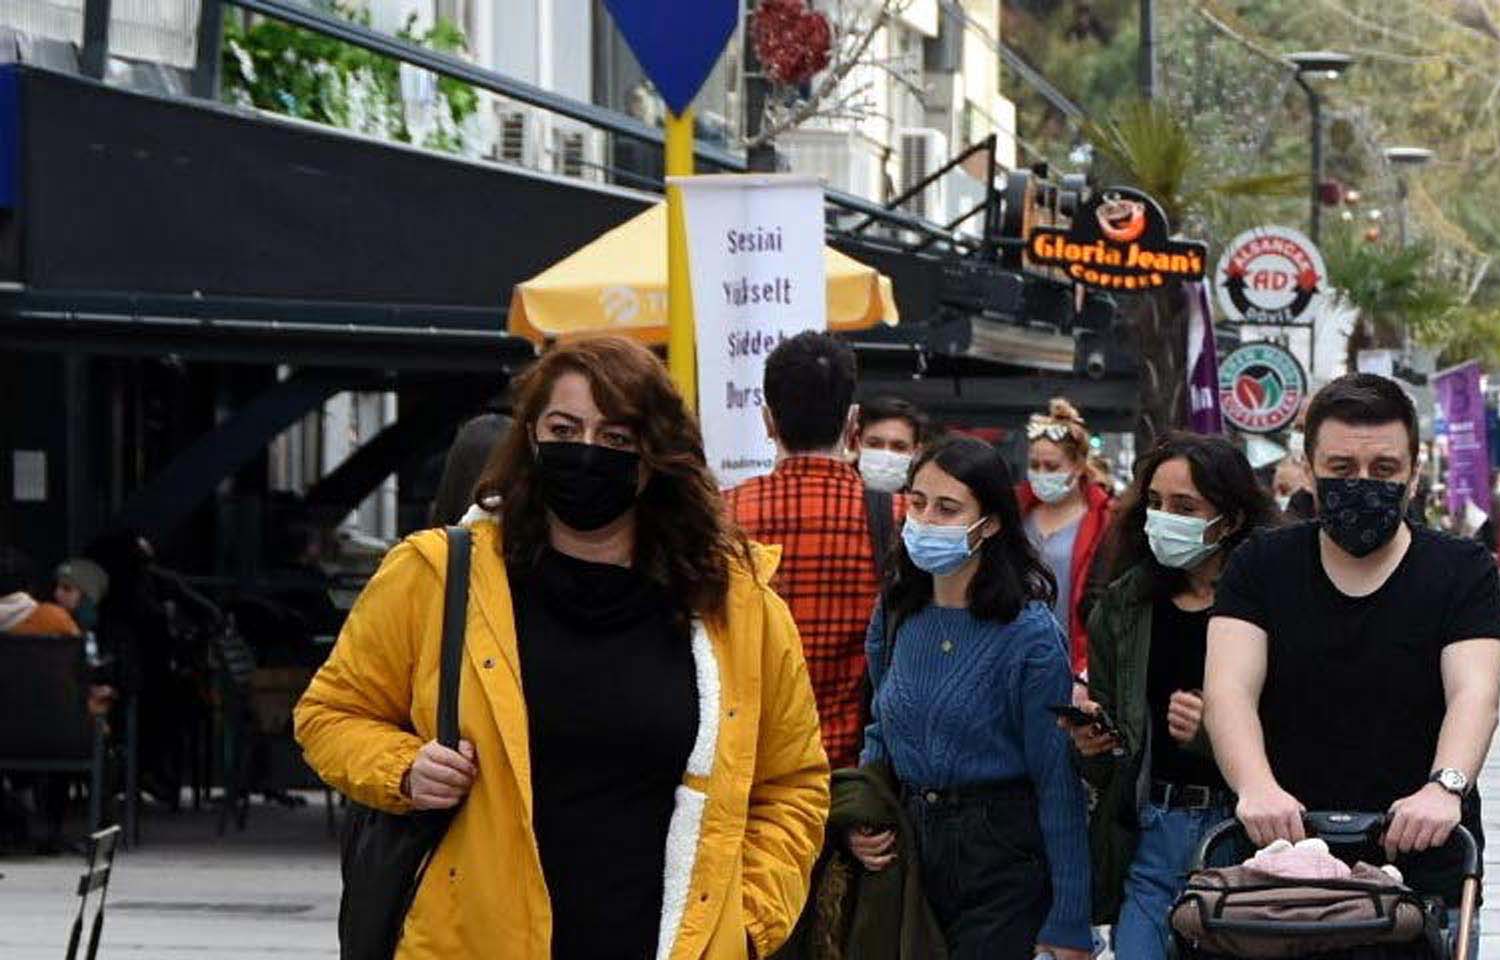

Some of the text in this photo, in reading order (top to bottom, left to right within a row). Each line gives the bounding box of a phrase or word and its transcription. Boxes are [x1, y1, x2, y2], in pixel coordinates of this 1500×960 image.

[727, 226, 783, 254] Sesini
[1033, 233, 1202, 273] Gloria Jean's
[1254, 269, 1288, 290] AD
